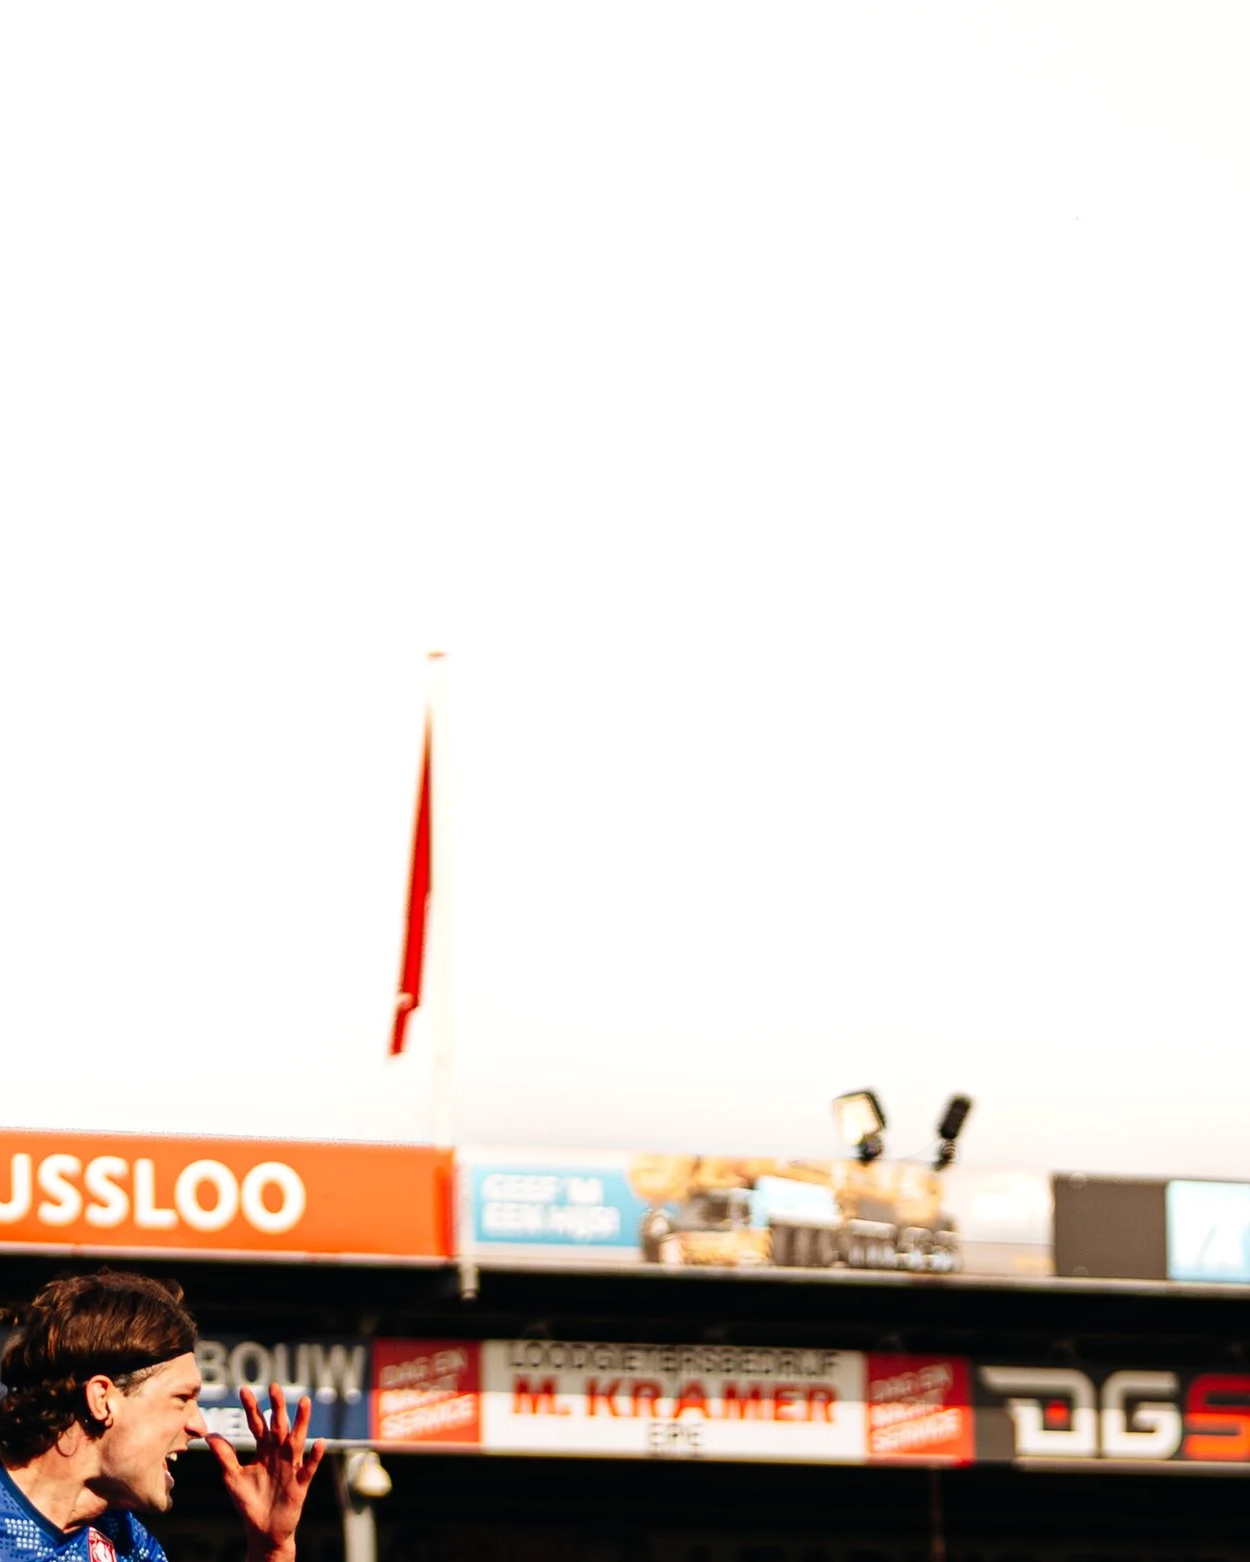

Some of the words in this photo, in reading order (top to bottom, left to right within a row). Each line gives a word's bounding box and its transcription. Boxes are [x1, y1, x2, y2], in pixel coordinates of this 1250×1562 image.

[196, 1339, 370, 1405] BOUW
[508, 1341, 839, 1377] LOODGIETERSBEDRIJF
[510, 1374, 571, 1417] M.
[587, 1378, 839, 1424] KRAMER
